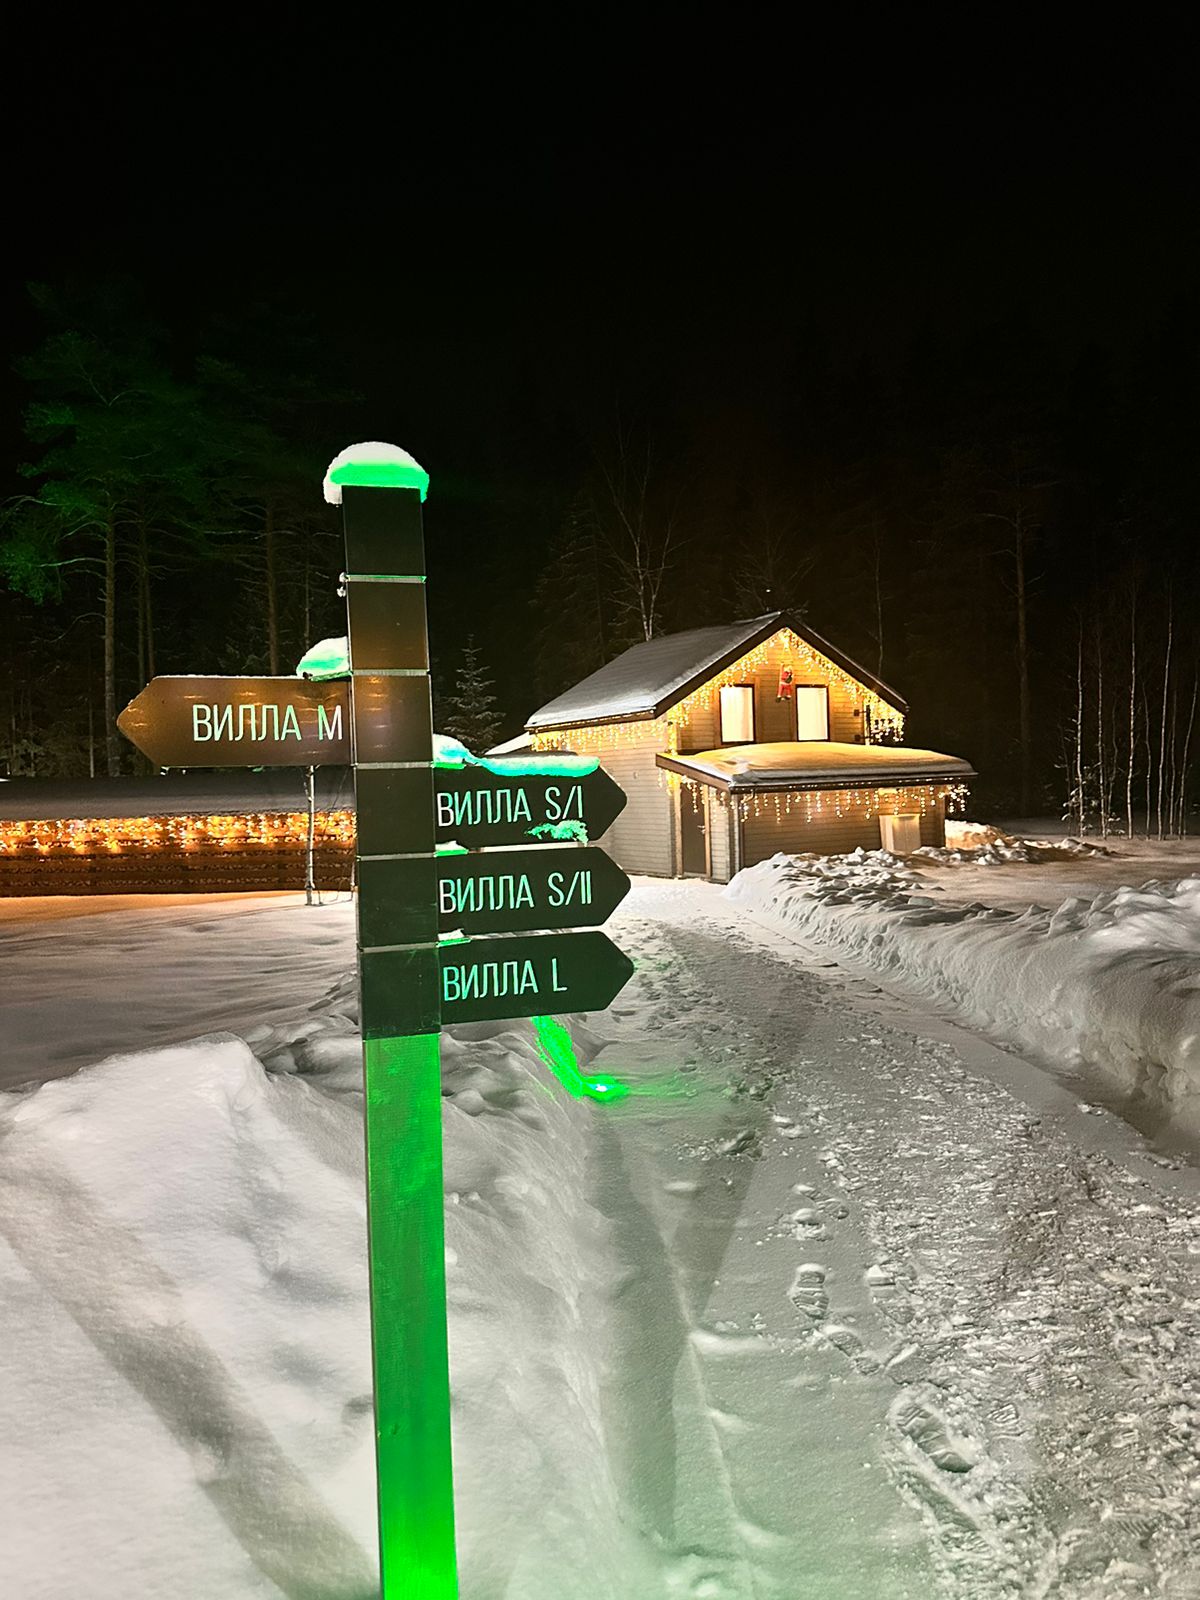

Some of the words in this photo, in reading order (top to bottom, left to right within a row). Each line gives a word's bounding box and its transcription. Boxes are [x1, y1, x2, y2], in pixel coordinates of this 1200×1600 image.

[192, 704, 302, 742] ВИЛЛА
[436, 788, 532, 827] ВИЛЛА
[544, 785, 584, 821] S/I
[439, 874, 535, 914] ВИЛЛА
[547, 870, 592, 907] S/II
[442, 960, 539, 1002] ВИЛЛА
[551, 958, 567, 992] L
